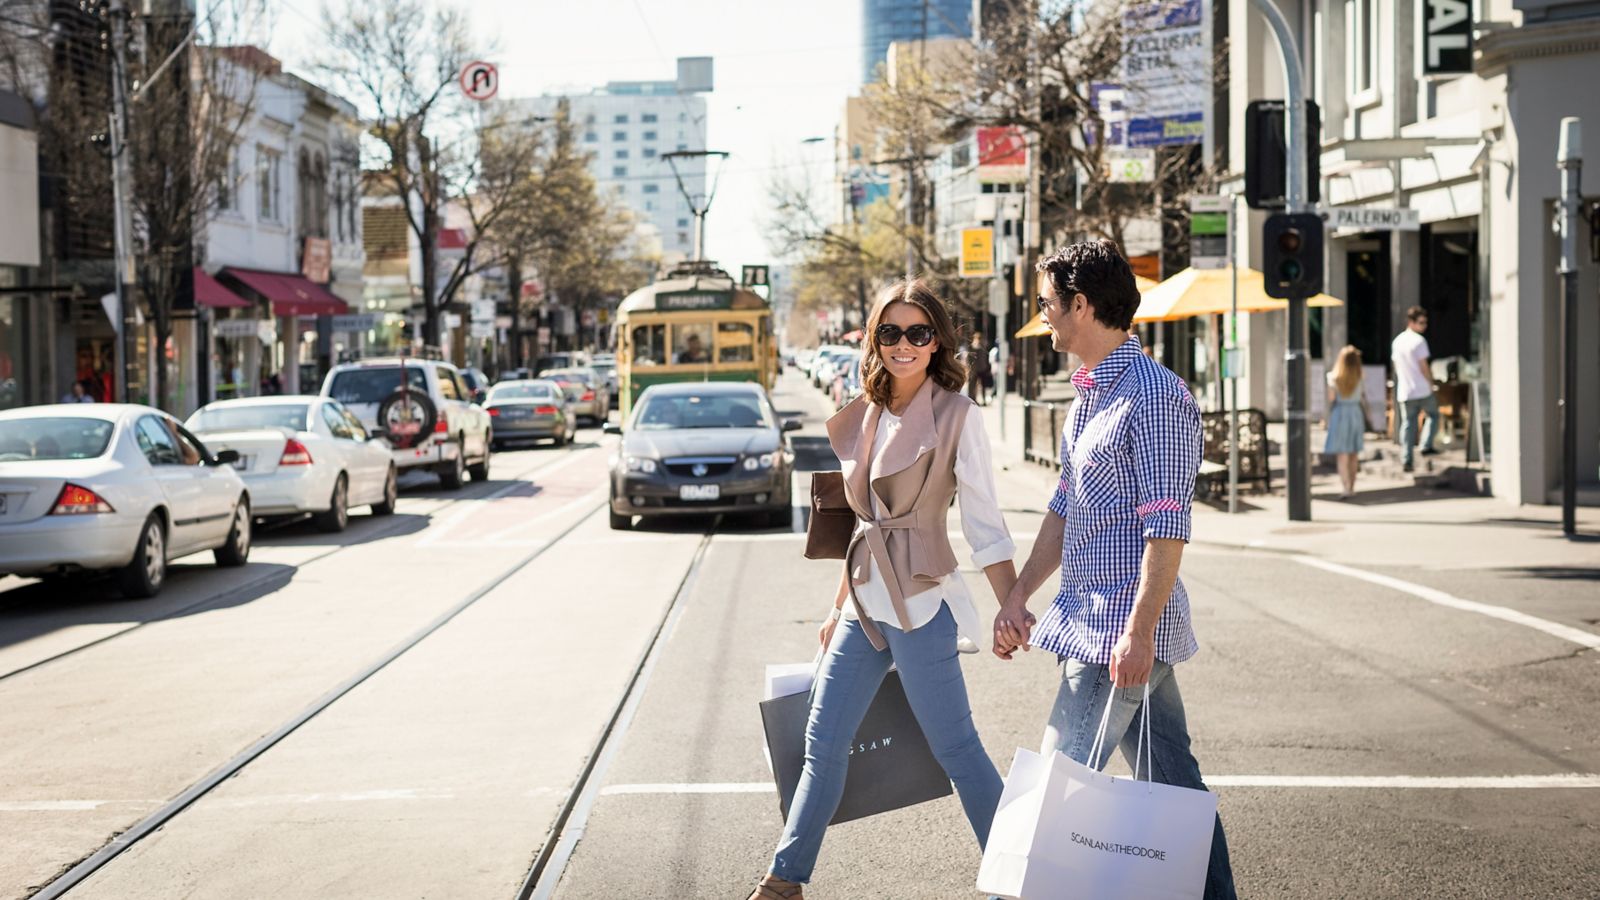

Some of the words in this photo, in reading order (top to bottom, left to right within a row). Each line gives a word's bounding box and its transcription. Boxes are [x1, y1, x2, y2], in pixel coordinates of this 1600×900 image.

[1337, 209, 1402, 226] PALERMO
[744, 267, 767, 286] 78
[1070, 831, 1166, 861] SCANLAN&THEODORE
